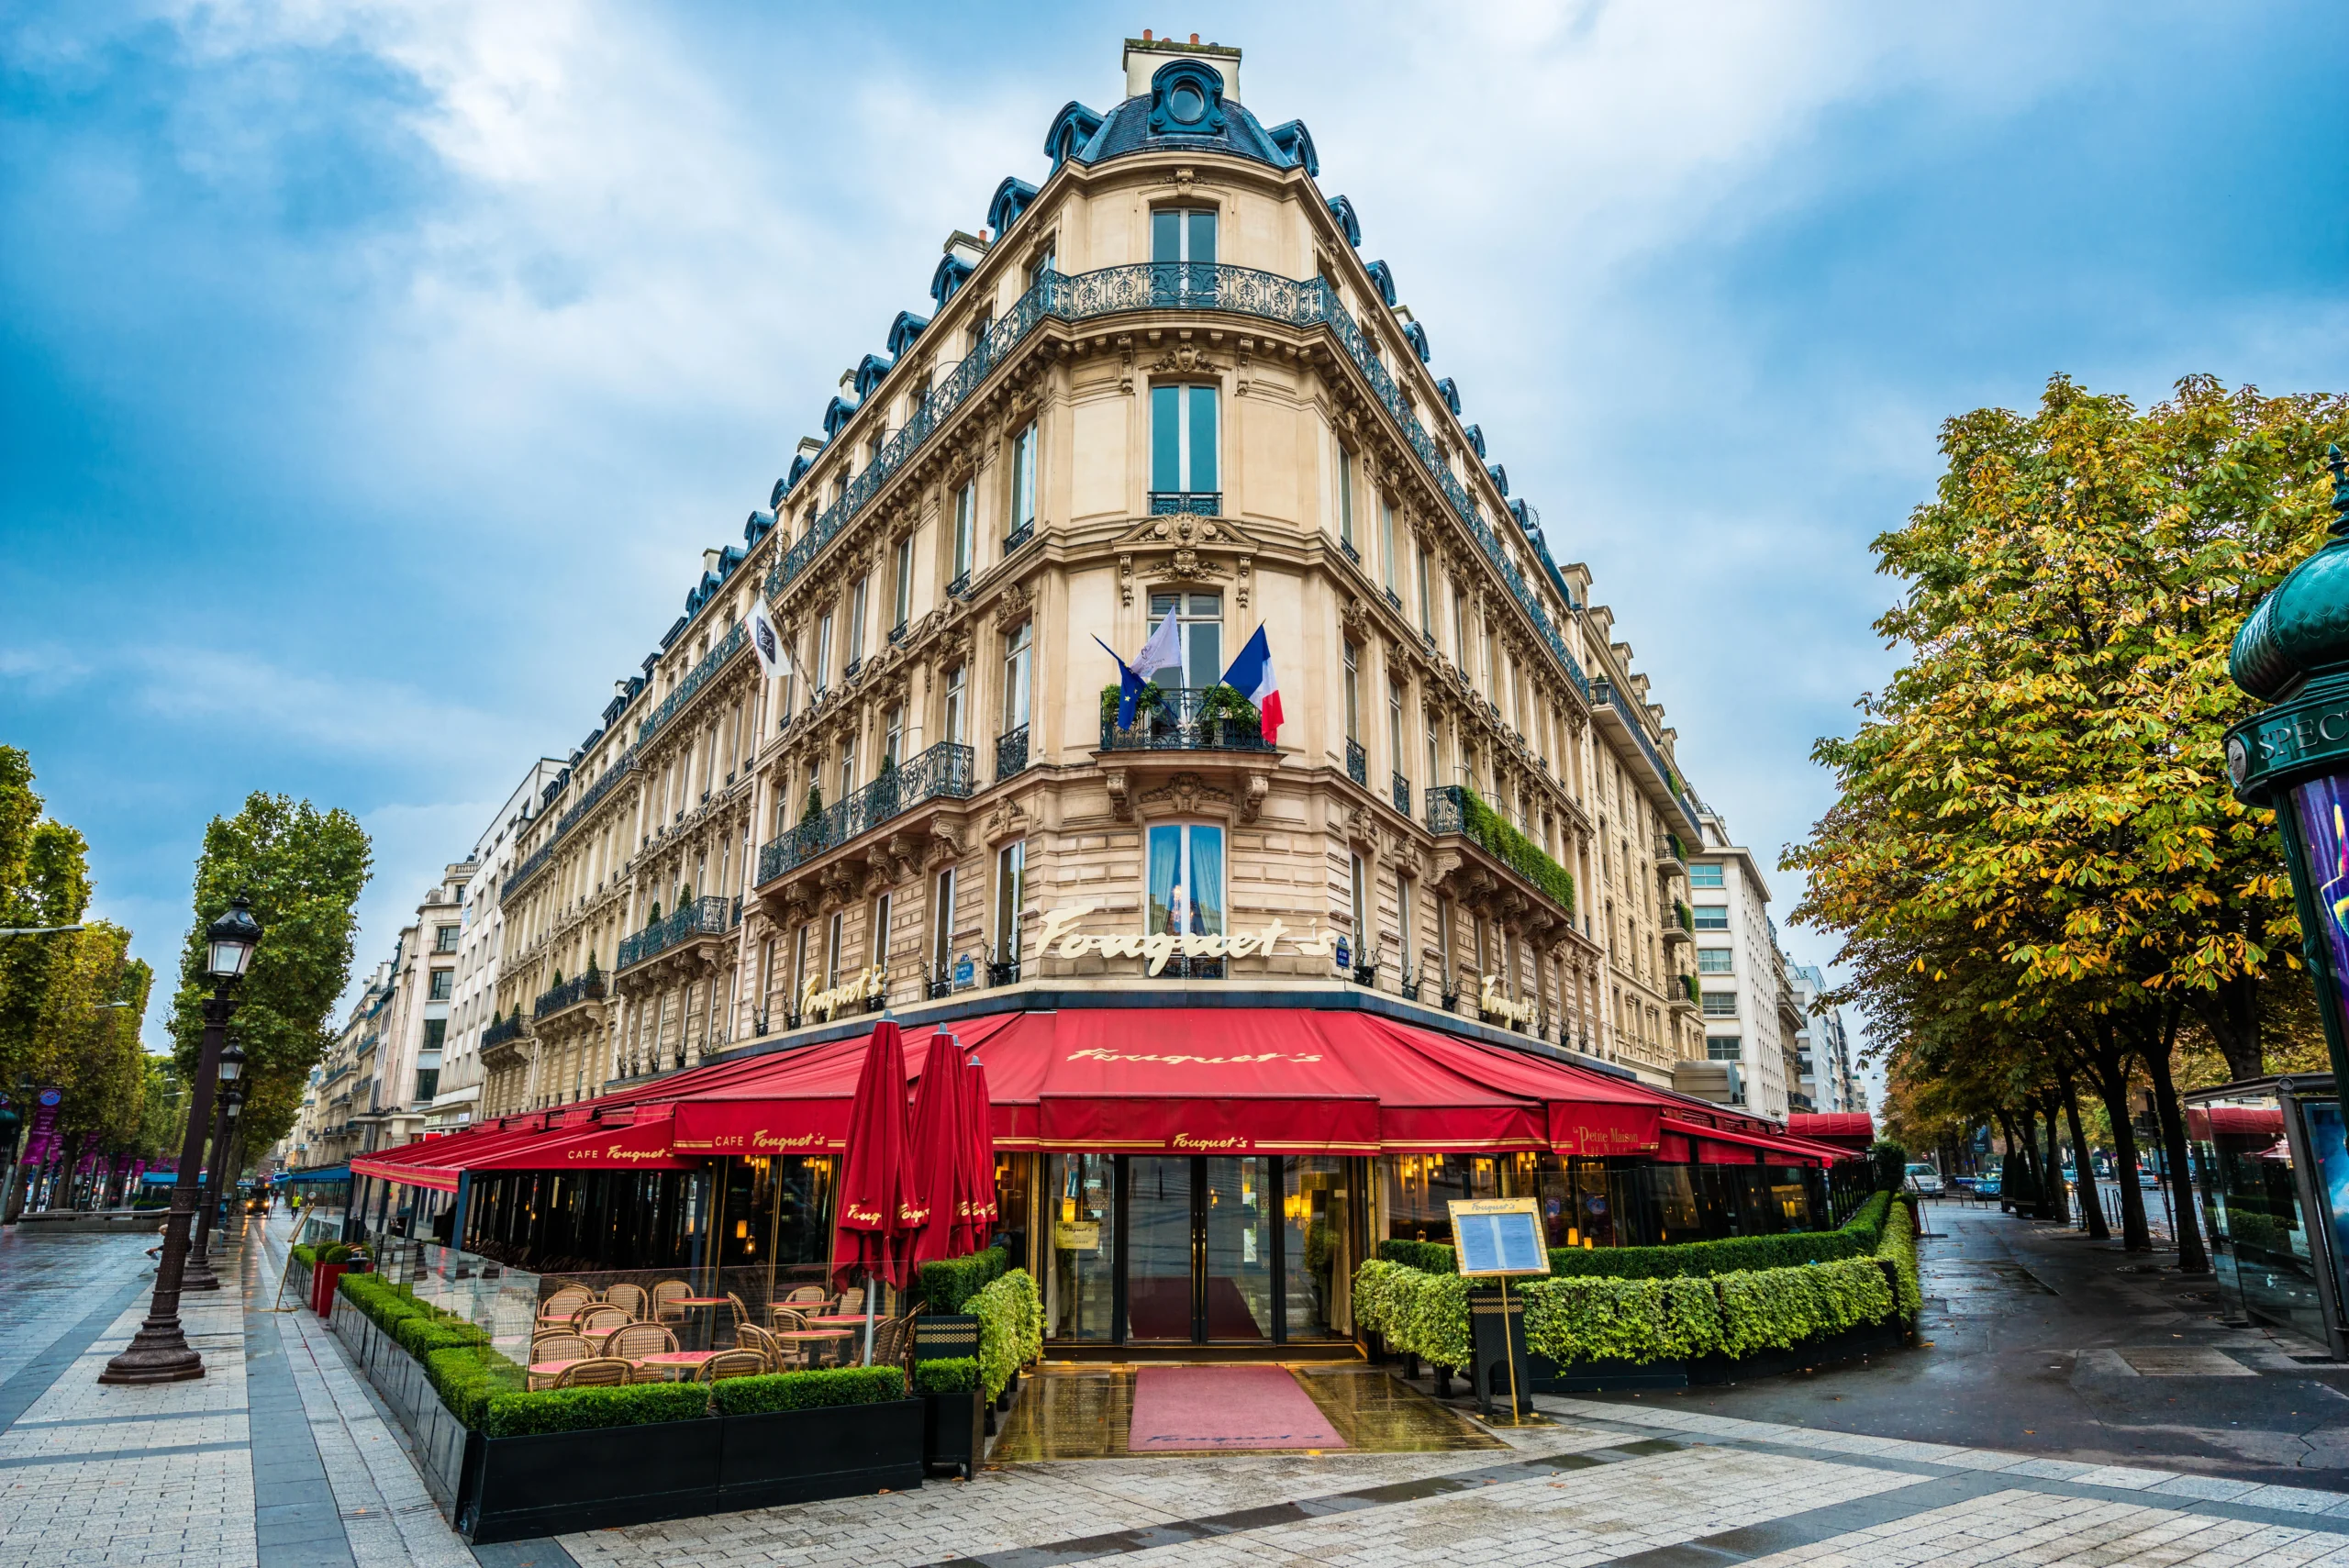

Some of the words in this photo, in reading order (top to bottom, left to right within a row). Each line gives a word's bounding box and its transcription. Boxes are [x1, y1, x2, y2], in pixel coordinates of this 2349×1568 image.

[2258, 710, 2349, 760] SPEC
[1035, 904, 1337, 977] Fouquet's
[800, 964, 885, 1022] Fouquet's
[1066, 1048, 1323, 1064] Fouquet's
[715, 1136, 743, 1147] CAFE
[752, 1129, 825, 1151] Fouquet's
[1173, 1133, 1248, 1151] Fouquet's
[1579, 1126, 1609, 1153] Petite
[1610, 1128, 1639, 1143] Maison
[568, 1150, 598, 1160] CAFE
